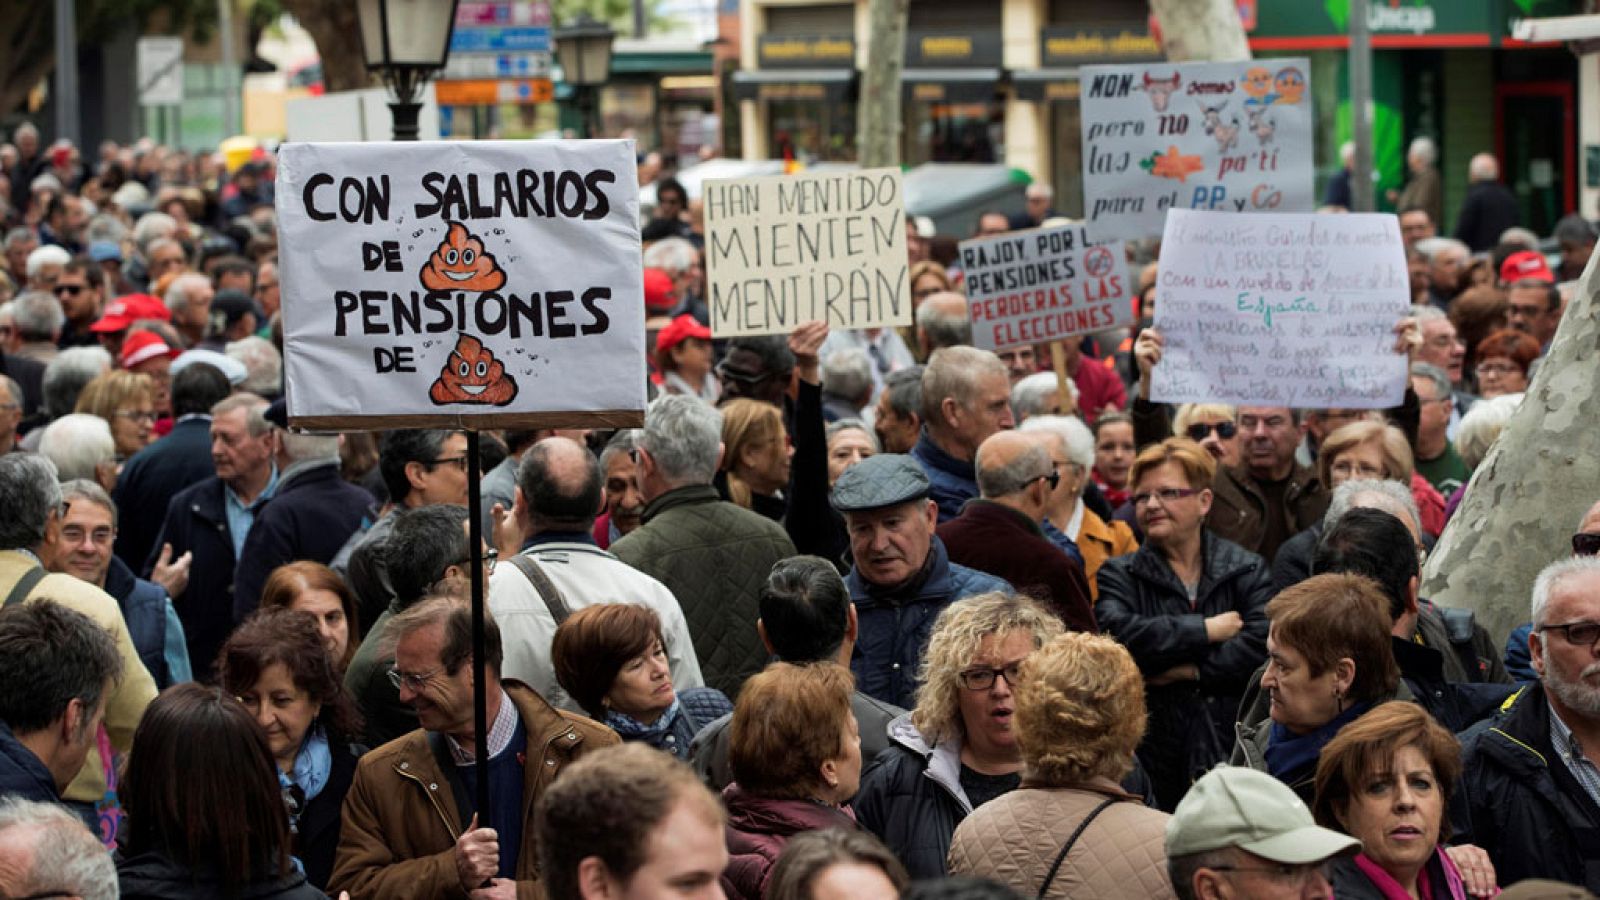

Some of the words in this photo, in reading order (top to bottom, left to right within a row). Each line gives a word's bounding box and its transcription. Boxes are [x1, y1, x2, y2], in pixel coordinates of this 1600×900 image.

[1087, 119, 1145, 142] pero
[1158, 113, 1190, 136] no
[1088, 147, 1131, 175] las
[302, 173, 390, 223] CON
[414, 168, 616, 220] SALARIOS
[707, 183, 760, 221] HAN
[778, 174, 896, 215] MENTIDO
[1091, 193, 1144, 221] para
[1157, 191, 1178, 210] el
[1234, 199, 1246, 212] y
[362, 241, 404, 272] DE
[710, 208, 900, 270] MIENTEN
[1036, 229, 1073, 256] POR
[967, 257, 1076, 296] PENSIONES
[334, 287, 612, 338] PENSIONES
[712, 262, 906, 333] MENTIRÁN
[970, 284, 1073, 324] PERDERAS
[1083, 275, 1123, 302] LAS
[1237, 292, 1321, 328] España
[992, 303, 1115, 348] ELECCIONES
[373, 347, 416, 373] DE
